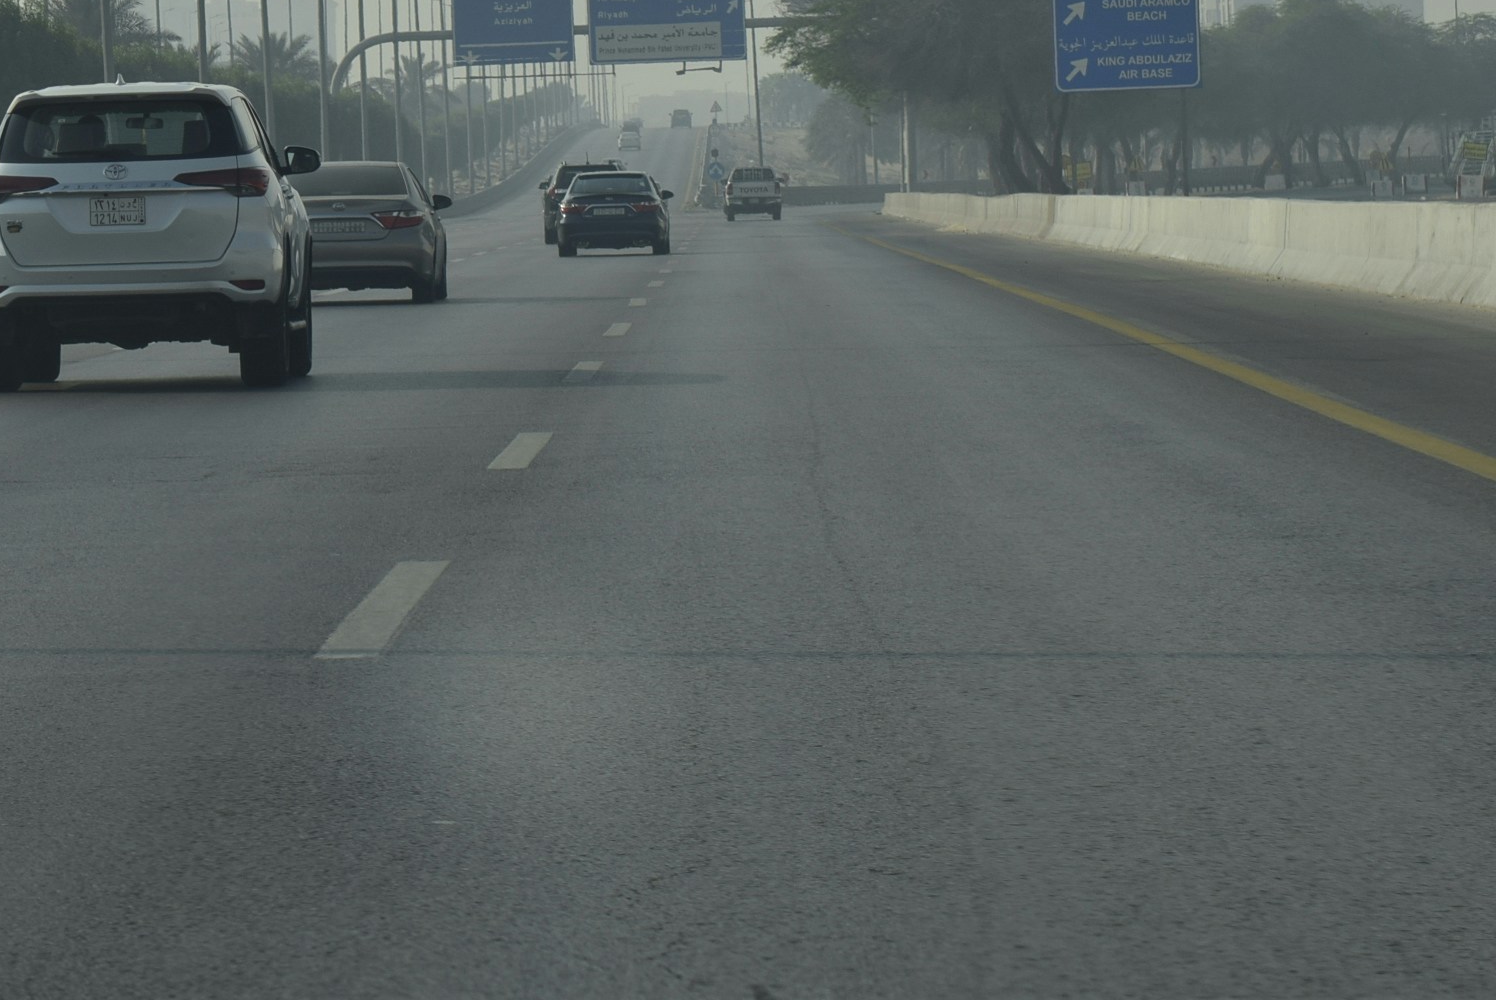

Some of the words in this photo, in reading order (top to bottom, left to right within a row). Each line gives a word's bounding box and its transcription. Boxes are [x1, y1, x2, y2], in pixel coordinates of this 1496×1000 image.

[493, 0, 533, 14] العزيزية
[676, 3, 717, 17] الرياض
[493, 17, 533, 26] Aziziyah
[597, 10, 629, 20] Riyadh
[1126, 10, 1167, 21] BEACH
[617, 33, 628, 42] بن
[631, 31, 658, 39] محمد
[662, 25, 684, 42] الأمير
[688, 26, 718, 39] جامعة
[1169, 32, 1194, 45] قاعدة
[1058, 37, 1086, 53] الجوية
[1142, 33, 1165, 46] الملك
[1097, 55, 1126, 67] KING
[1128, 53, 1193, 66] ABDULAZIZ
[1118, 68, 1138, 80] AIR
[1141, 67, 1173, 79] BASE
[739, 186, 769, 194] TOYOTA
[94, 213, 117, 225] 1214
